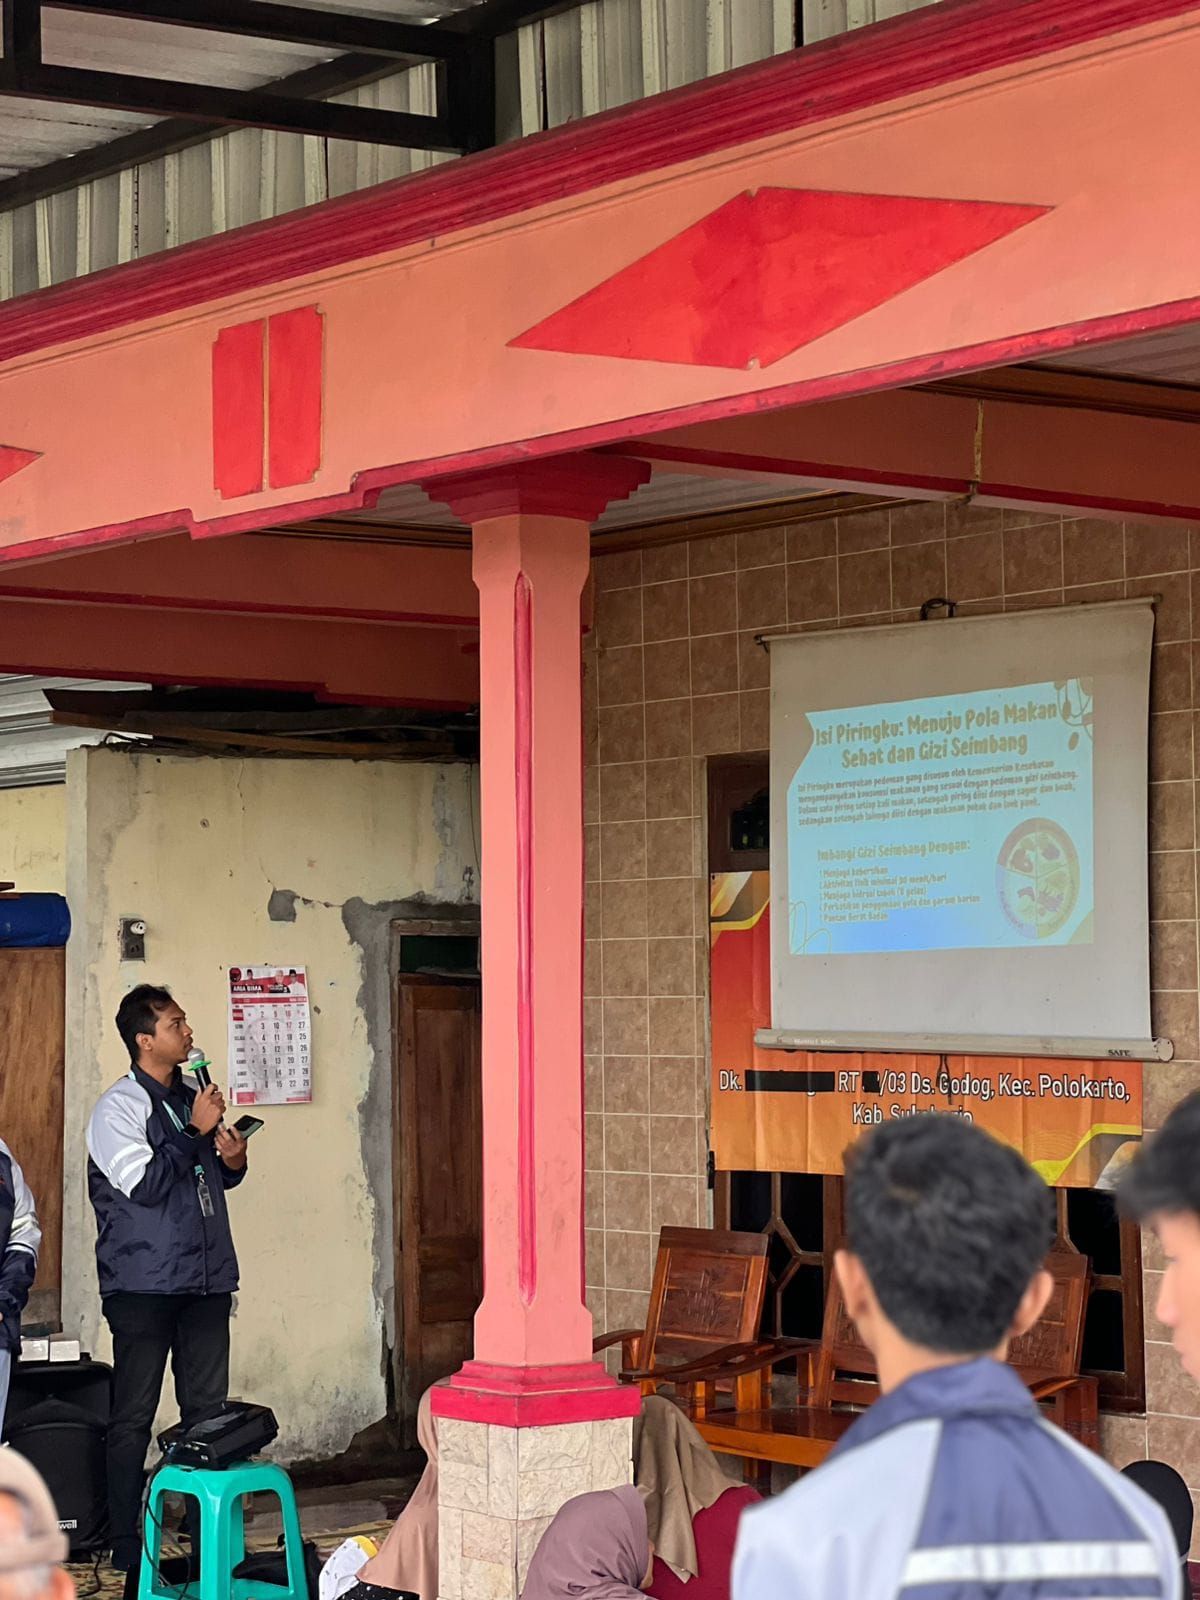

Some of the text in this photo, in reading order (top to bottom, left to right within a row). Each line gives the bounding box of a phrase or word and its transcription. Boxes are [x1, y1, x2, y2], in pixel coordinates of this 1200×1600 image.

[816, 701, 1057, 746] Isi Piringku: Menuju Pola Makan
[841, 734, 1028, 769] Sehat dan Gizi Seimbang
[719, 1070, 743, 1091] Dk.
[838, 1071, 860, 1092] RT
[910, 1072, 935, 1095] Ds.
[939, 1072, 995, 1101] Godog,
[999, 1073, 1036, 1096] Kec.
[1039, 1073, 1131, 1104] Polokarto,
